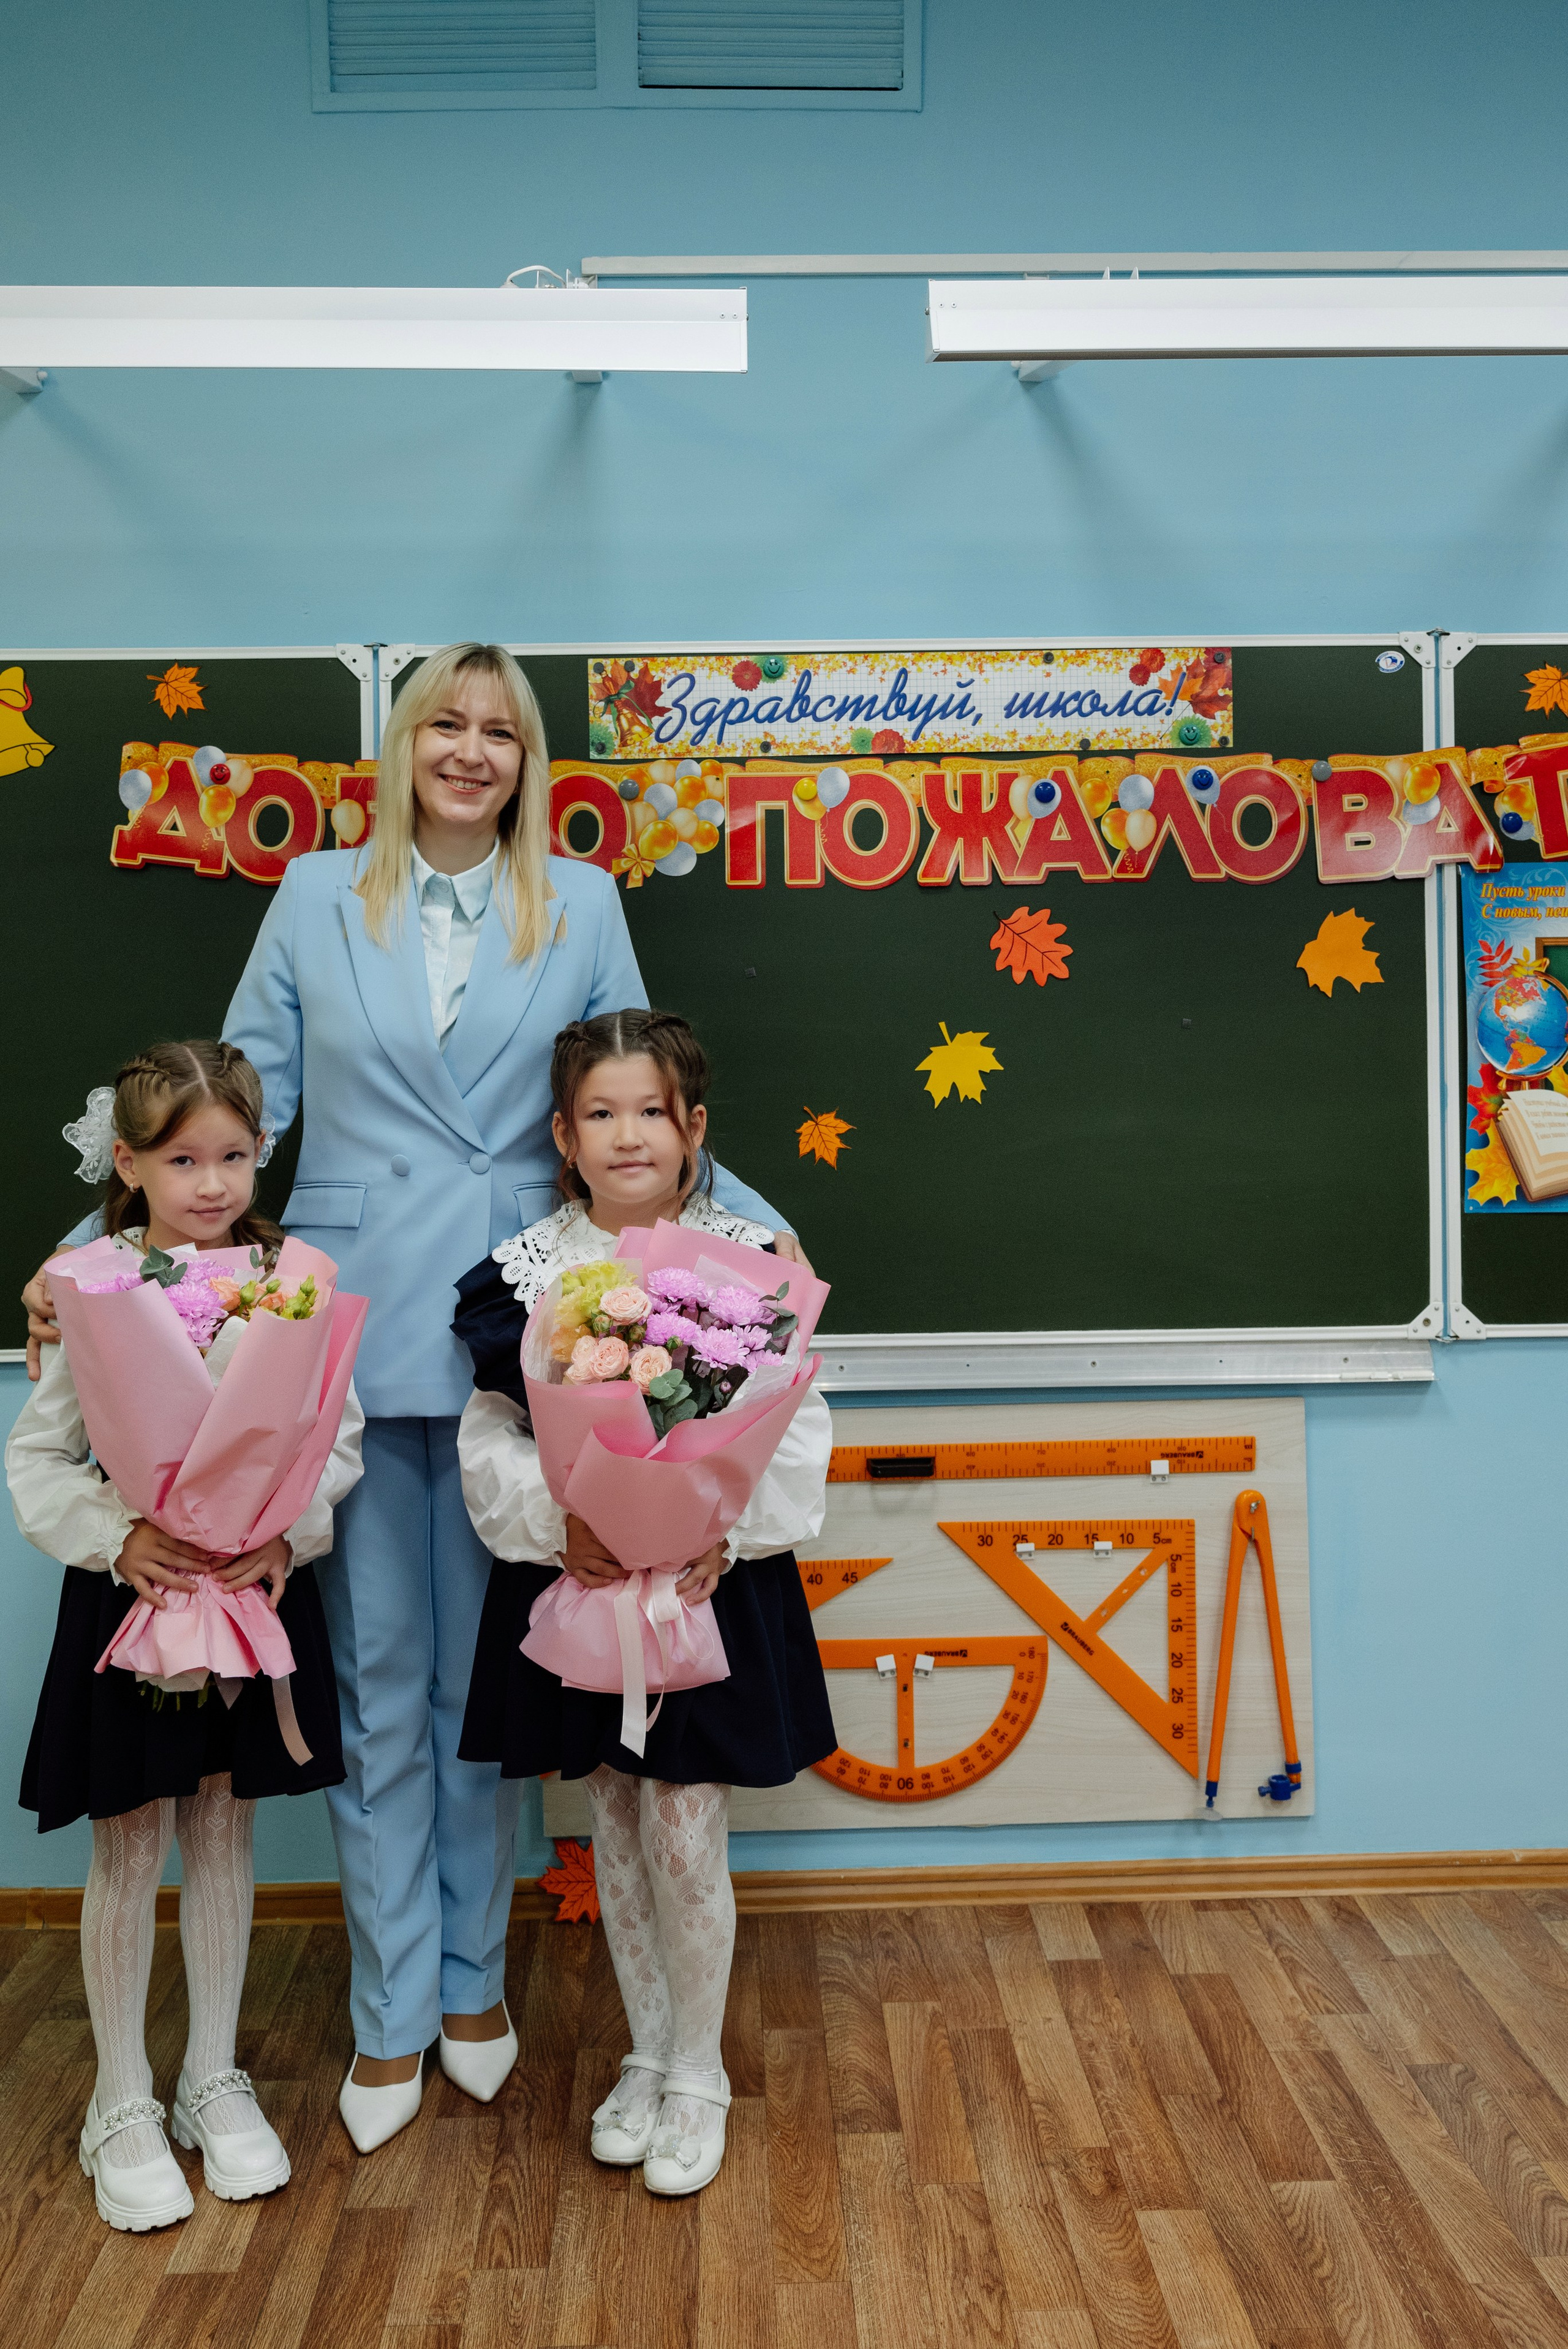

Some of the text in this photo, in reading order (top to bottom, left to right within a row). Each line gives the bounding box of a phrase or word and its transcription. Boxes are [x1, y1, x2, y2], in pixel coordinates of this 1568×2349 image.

[654, 667, 1187, 746] Здравствуй, школа!
[110, 755, 635, 886] ДОО
[1480, 883, 1566, 902] Пусть уроки
[1481, 903, 1493, 919] С
[1494, 906, 1542, 920] новым,
[978, 1535, 993, 1546] 30
[1048, 1534, 1063, 1545] 20
[1120, 1533, 1134, 1545] 10
[807, 1572, 858, 1585] 40 45
[1170, 1582, 1182, 1597] 10
[1171, 1617, 1182, 1632] 15
[1068, 1628, 1095, 1655] BRAUBERG
[1171, 1652, 1183, 1668] 20
[1172, 1688, 1183, 1703] 25
[1172, 1723, 1183, 1739] 30
[897, 1777, 914, 1790] 90
